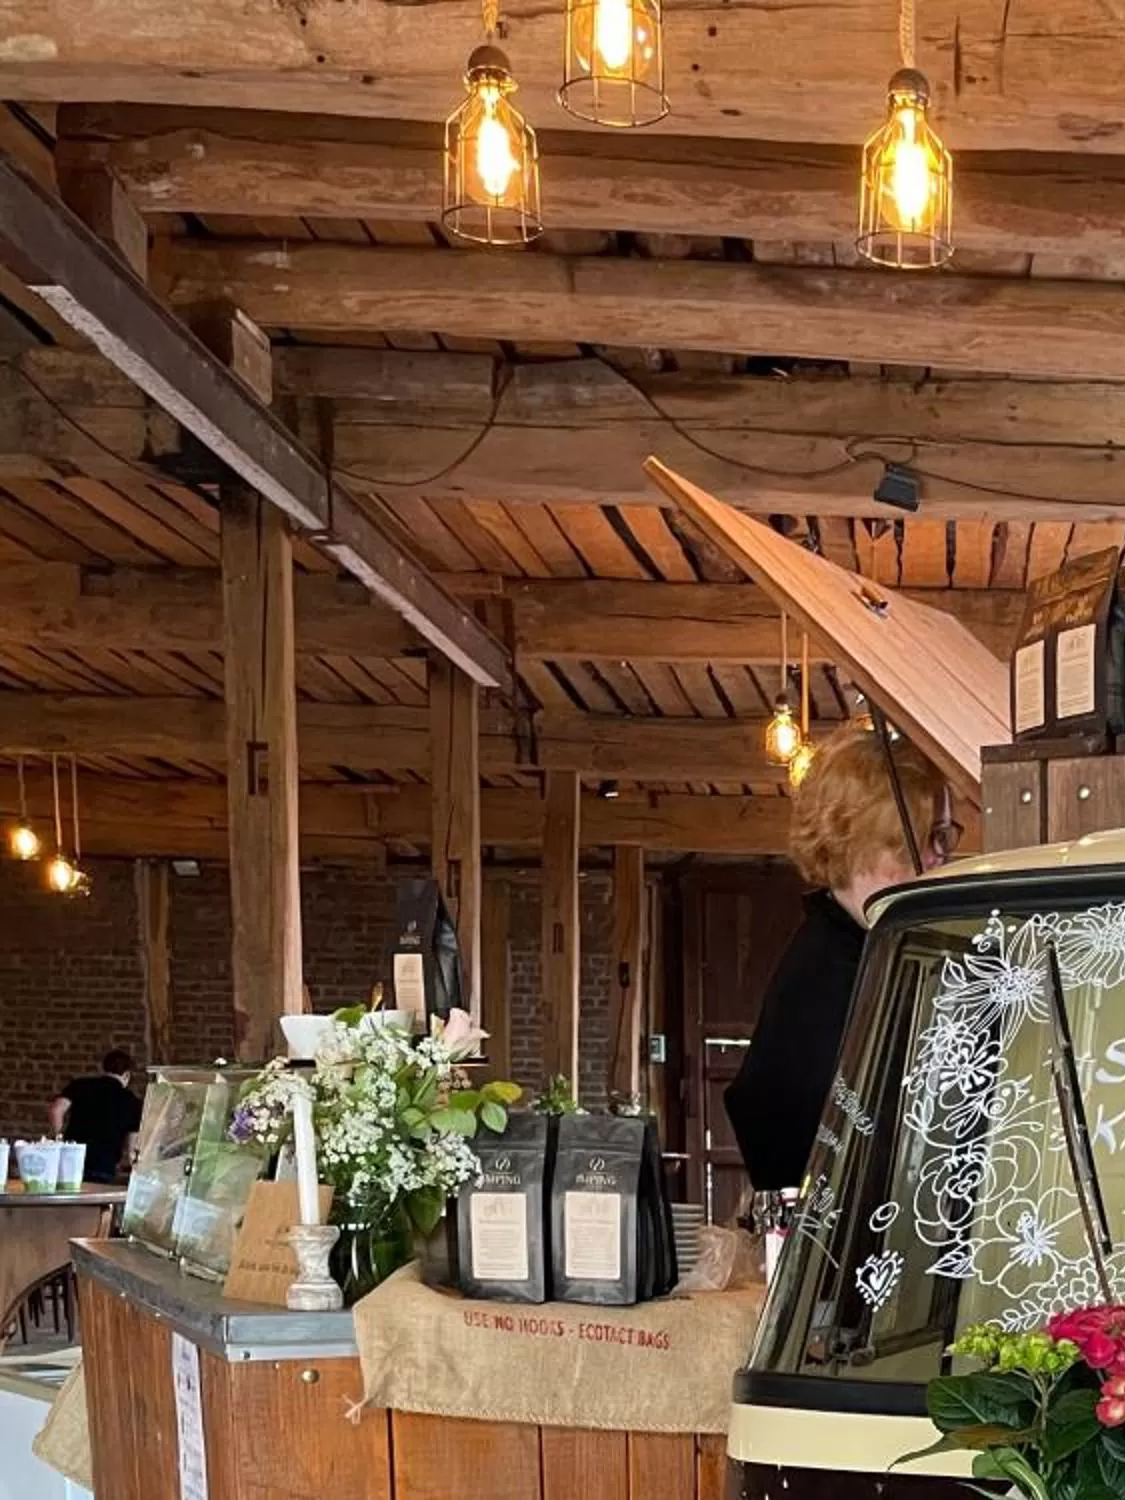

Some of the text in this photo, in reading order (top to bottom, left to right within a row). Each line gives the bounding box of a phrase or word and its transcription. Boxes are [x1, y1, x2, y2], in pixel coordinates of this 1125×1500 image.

[463, 1311, 490, 1328] USE
[493, 1315, 514, 1332] NO
[636, 1328, 671, 1350] BAGS
